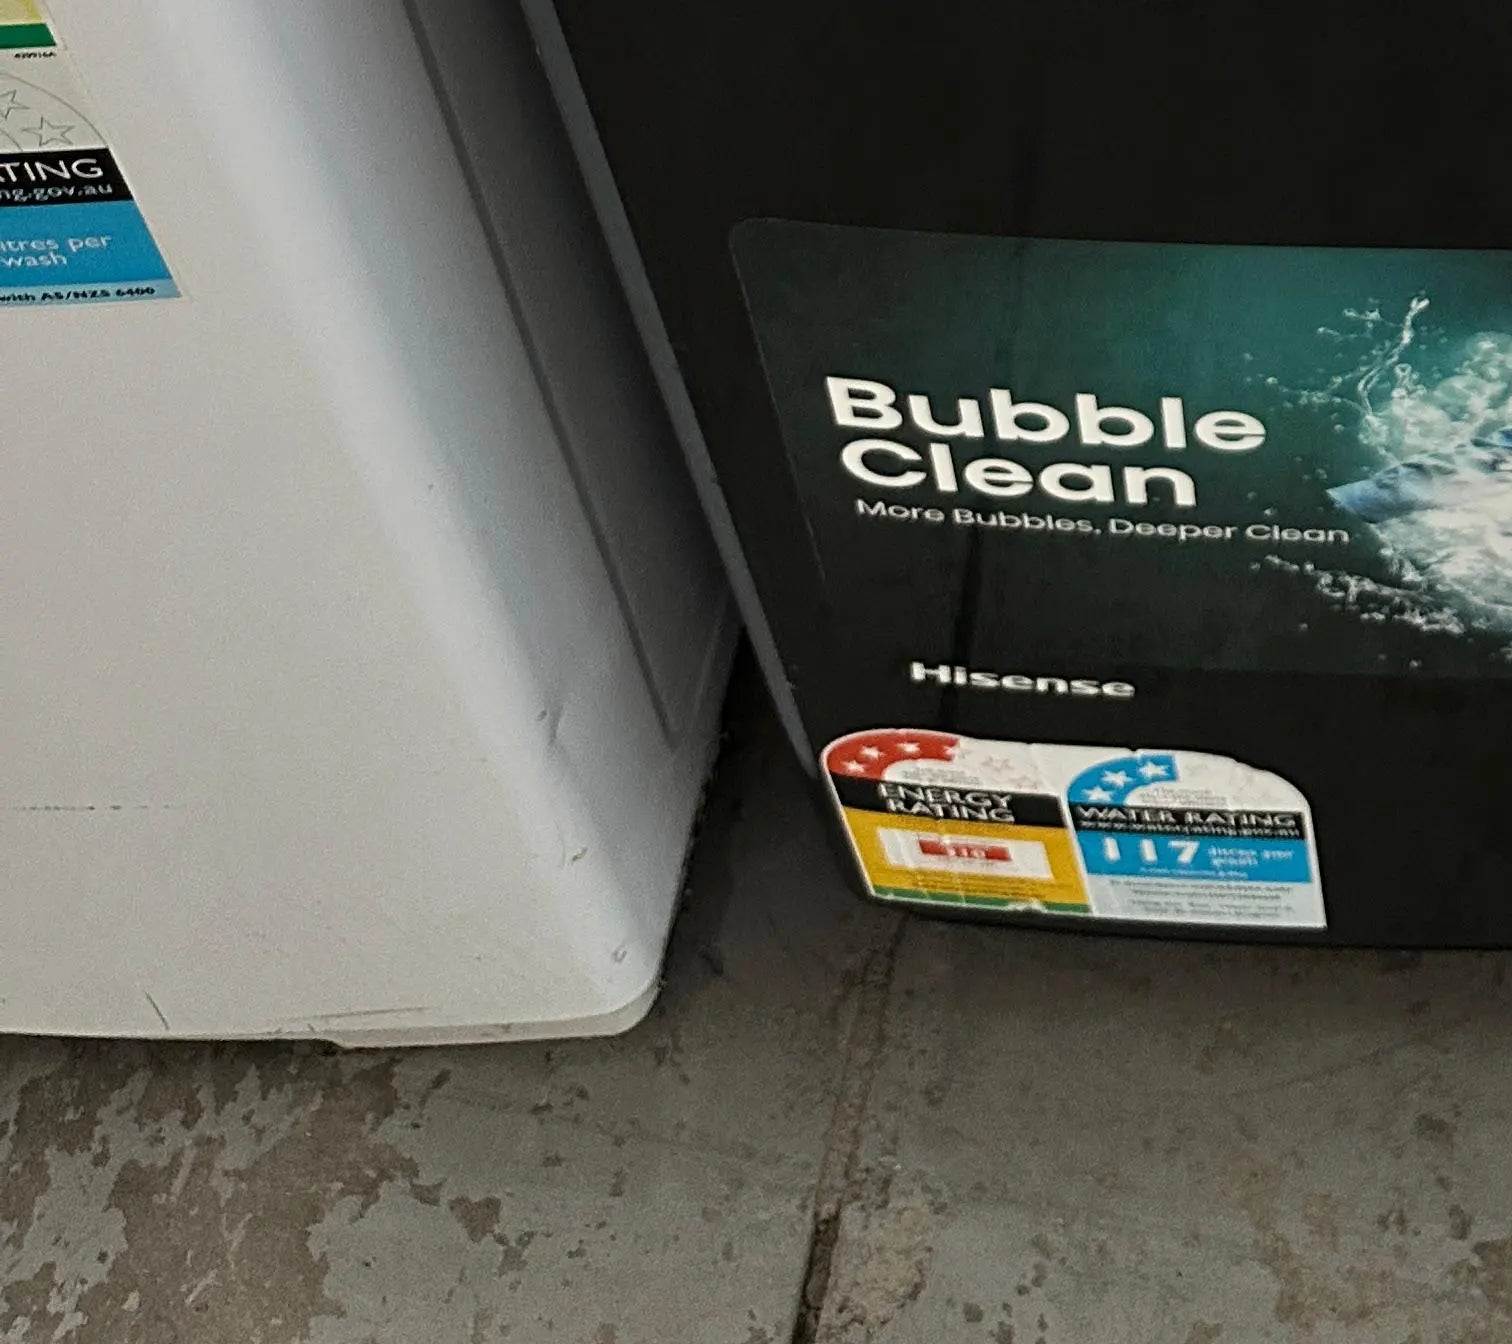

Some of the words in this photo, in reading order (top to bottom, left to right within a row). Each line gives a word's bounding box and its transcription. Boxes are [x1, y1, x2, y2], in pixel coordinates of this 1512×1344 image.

[0, 158, 104, 183] TING
[68, 235, 112, 253] per
[0, 250, 68, 268] wash
[825, 375, 1267, 453] Bubble
[840, 438, 1197, 508] Clean
[855, 498, 945, 524] More
[953, 506, 1102, 536] Bubbles,
[1109, 517, 1237, 543] Deeper
[1244, 522, 1350, 544] Clean
[910, 660, 1136, 700] Hisense
[878, 783, 1013, 809] ENERGY
[887, 799, 1016, 823] RATING
[1076, 805, 1178, 823] WATER
[1184, 810, 1297, 827] RATING
[1103, 837, 1200, 864] 117
